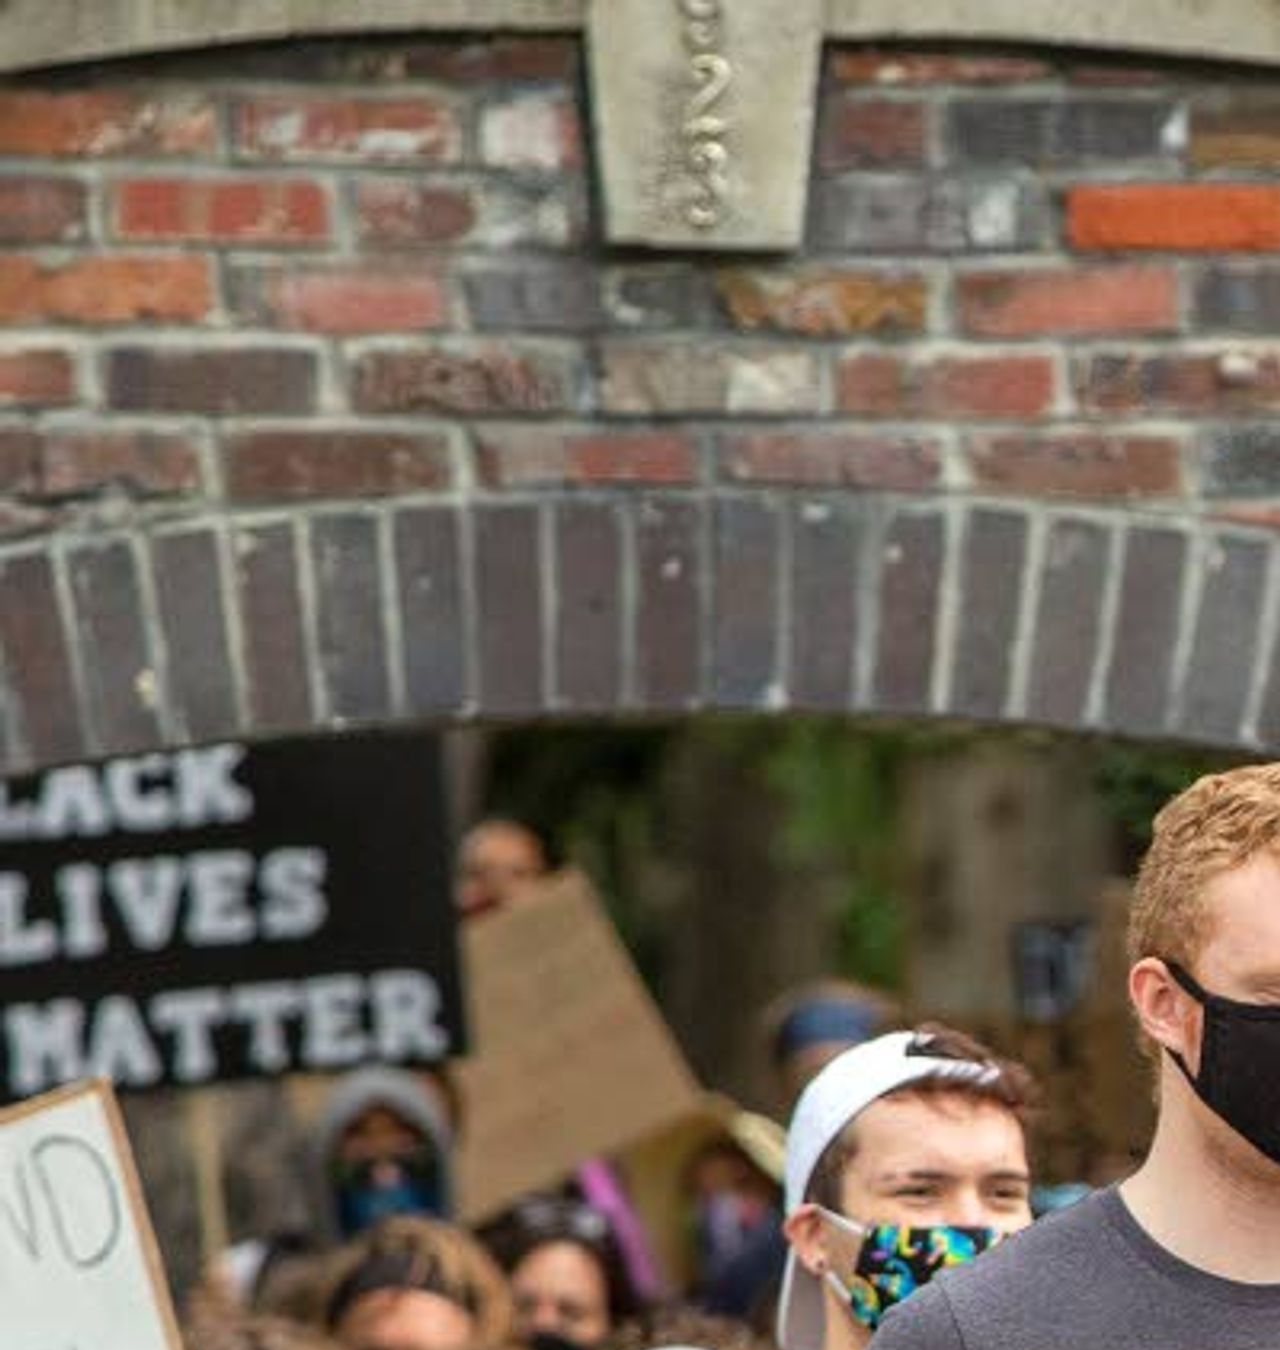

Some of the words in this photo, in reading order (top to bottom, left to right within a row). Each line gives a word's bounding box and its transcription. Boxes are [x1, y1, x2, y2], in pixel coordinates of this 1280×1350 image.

[0, 743, 253, 840] LACK
[0, 846, 327, 966] LIVES
[5, 970, 448, 1096] MATTER
